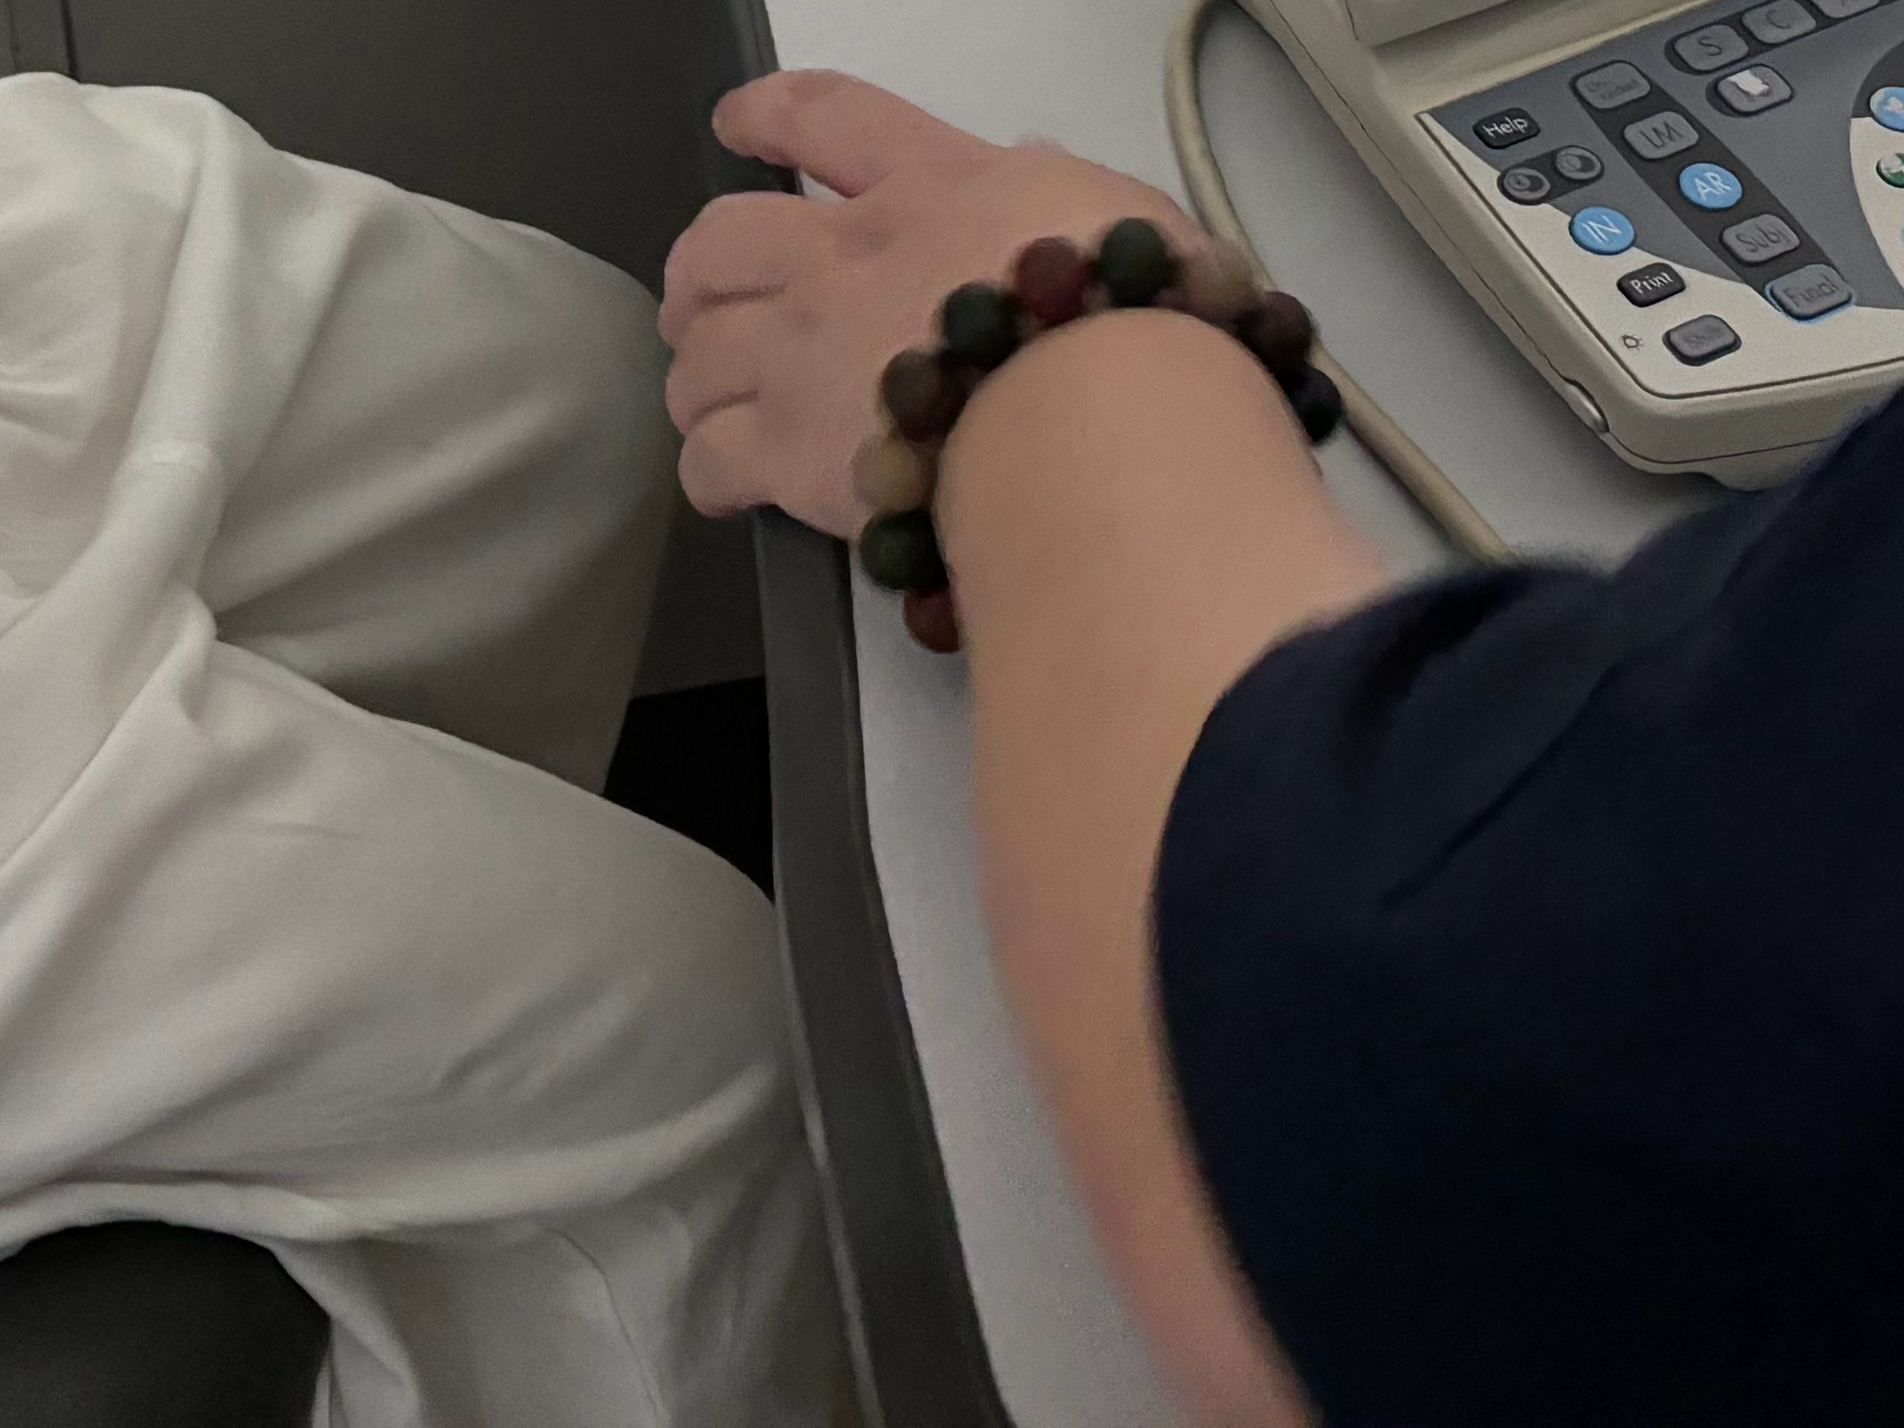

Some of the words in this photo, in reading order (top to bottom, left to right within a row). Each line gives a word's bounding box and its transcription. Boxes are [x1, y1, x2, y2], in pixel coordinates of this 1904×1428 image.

[1765, 8, 1792, 30] C
[1697, 35, 1724, 58] S
[1483, 115, 1529, 139] Help
[1693, 170, 1733, 201] AR
[1580, 214, 1623, 243] IN
[1630, 271, 1674, 295] Print
